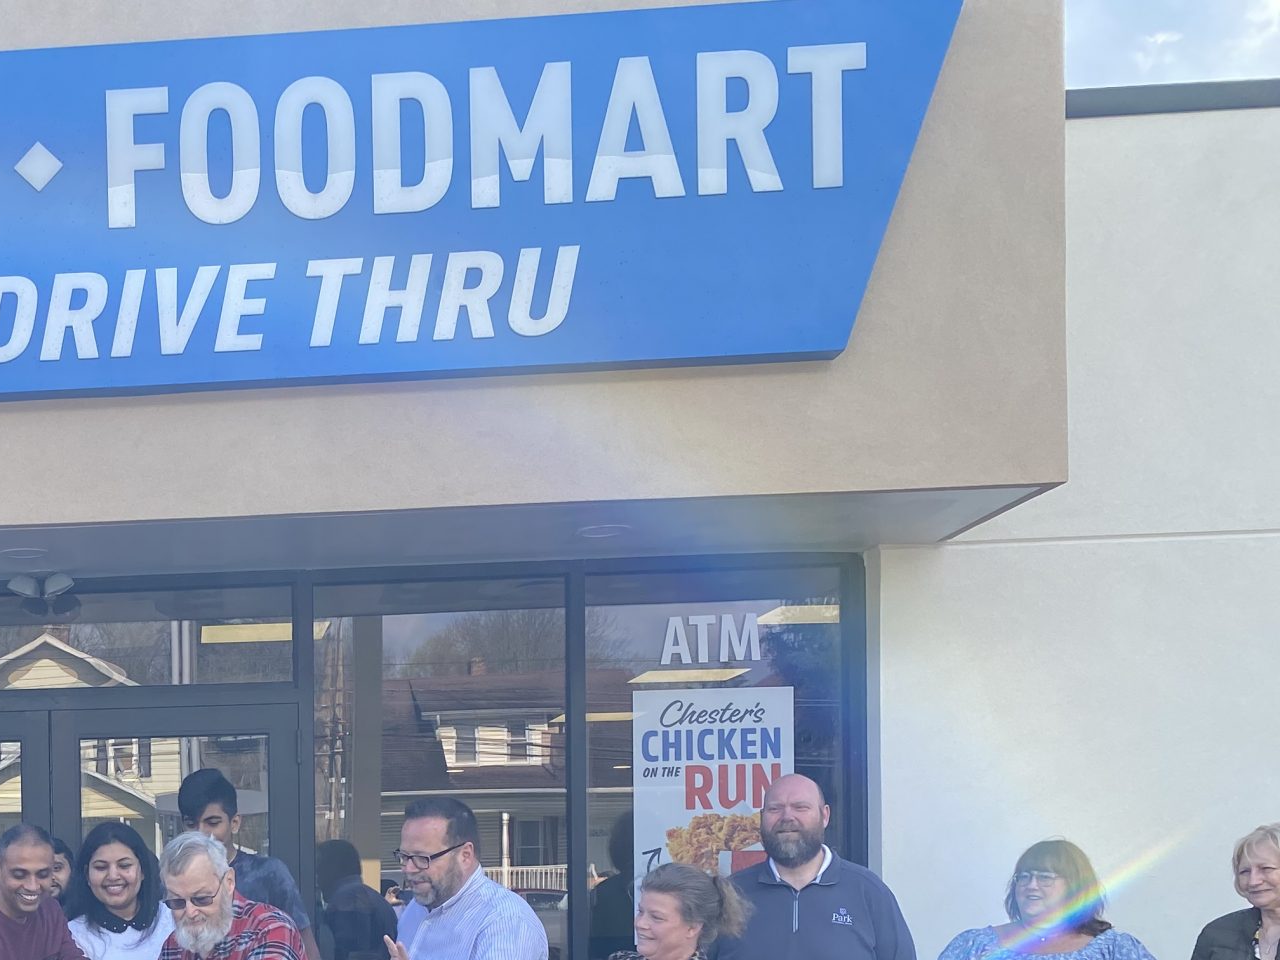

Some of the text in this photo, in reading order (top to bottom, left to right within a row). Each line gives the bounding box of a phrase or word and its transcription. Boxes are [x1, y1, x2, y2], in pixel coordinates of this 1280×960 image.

[105, 41, 867, 229] FOODMART
[305, 244, 580, 348] THRU
[660, 612, 761, 665] ATM
[659, 699, 766, 728] Chester's
[641, 727, 781, 763] CHICKEN
[642, 763, 781, 811] ON THE RUN
[831, 912, 853, 923] Park
